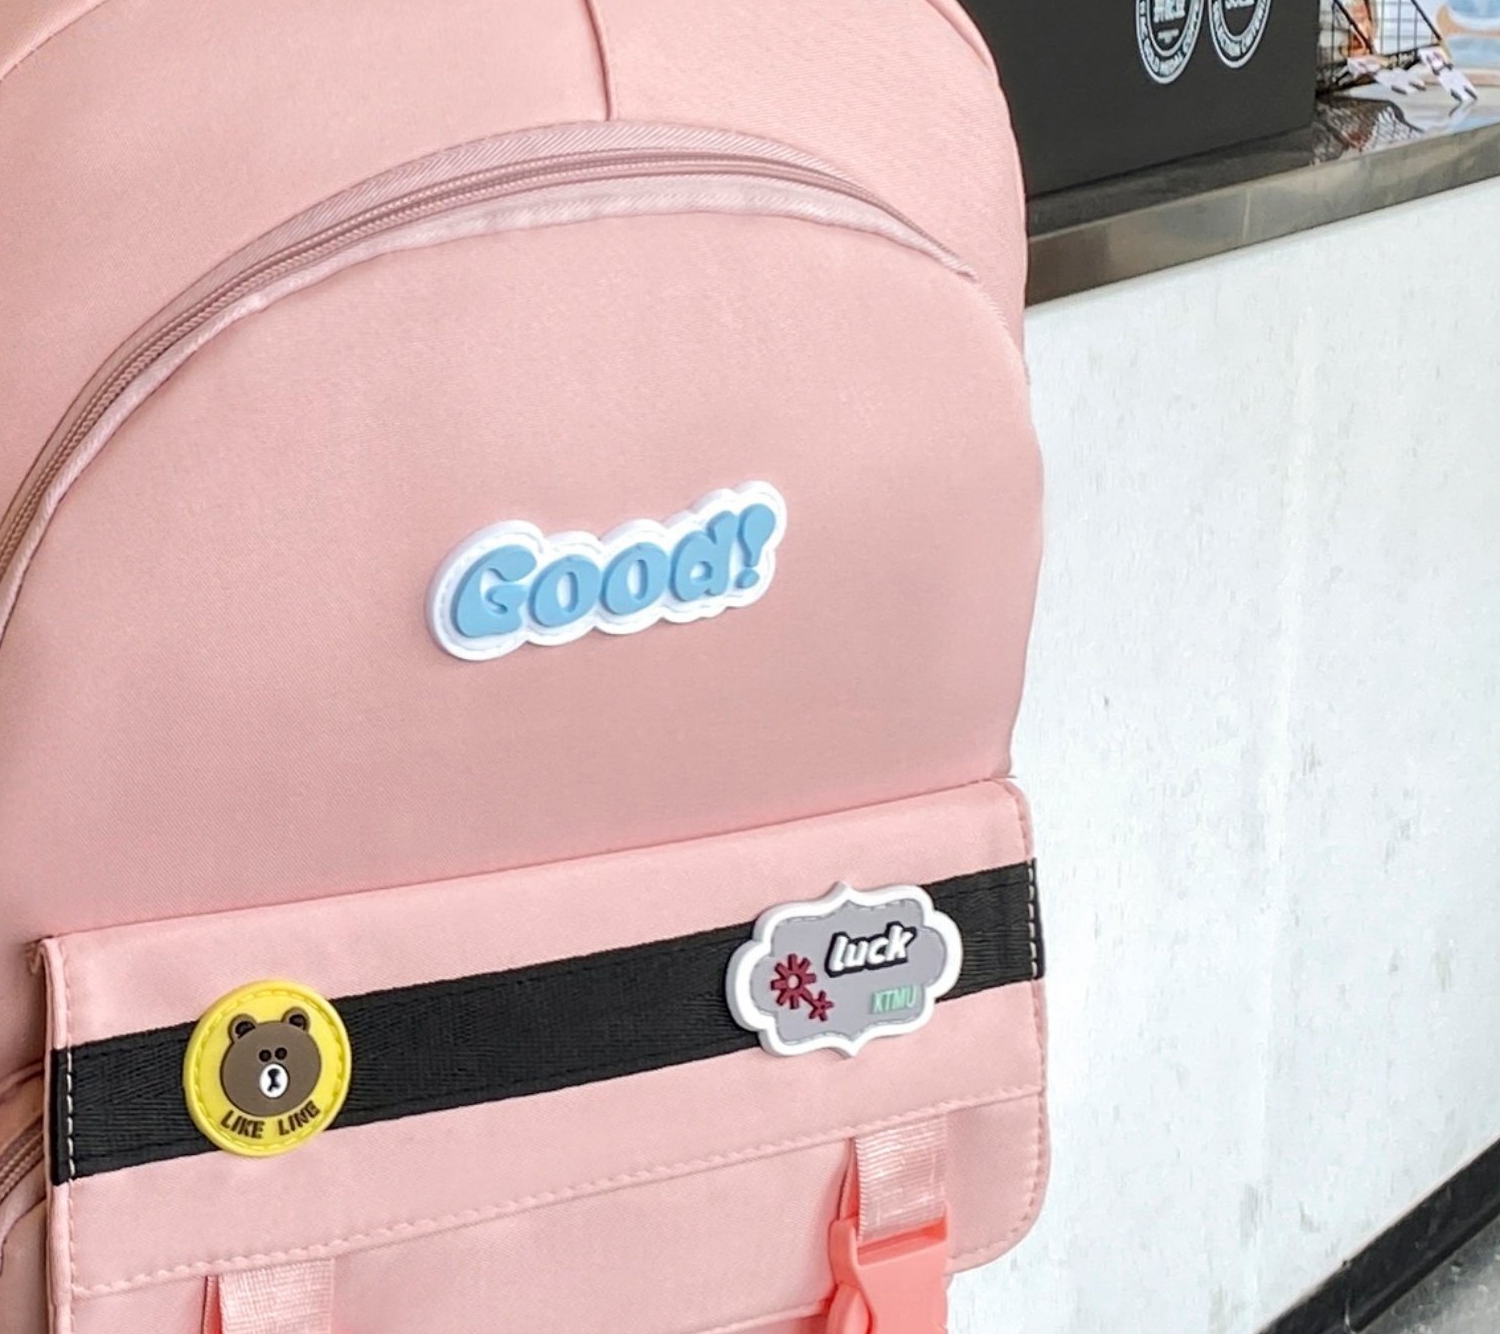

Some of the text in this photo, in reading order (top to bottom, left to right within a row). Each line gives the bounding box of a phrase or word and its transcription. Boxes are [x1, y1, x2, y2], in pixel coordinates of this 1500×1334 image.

[452, 502, 777, 639] Good!
[825, 921, 917, 978] luck
[220, 1109, 266, 1140] LIKE
